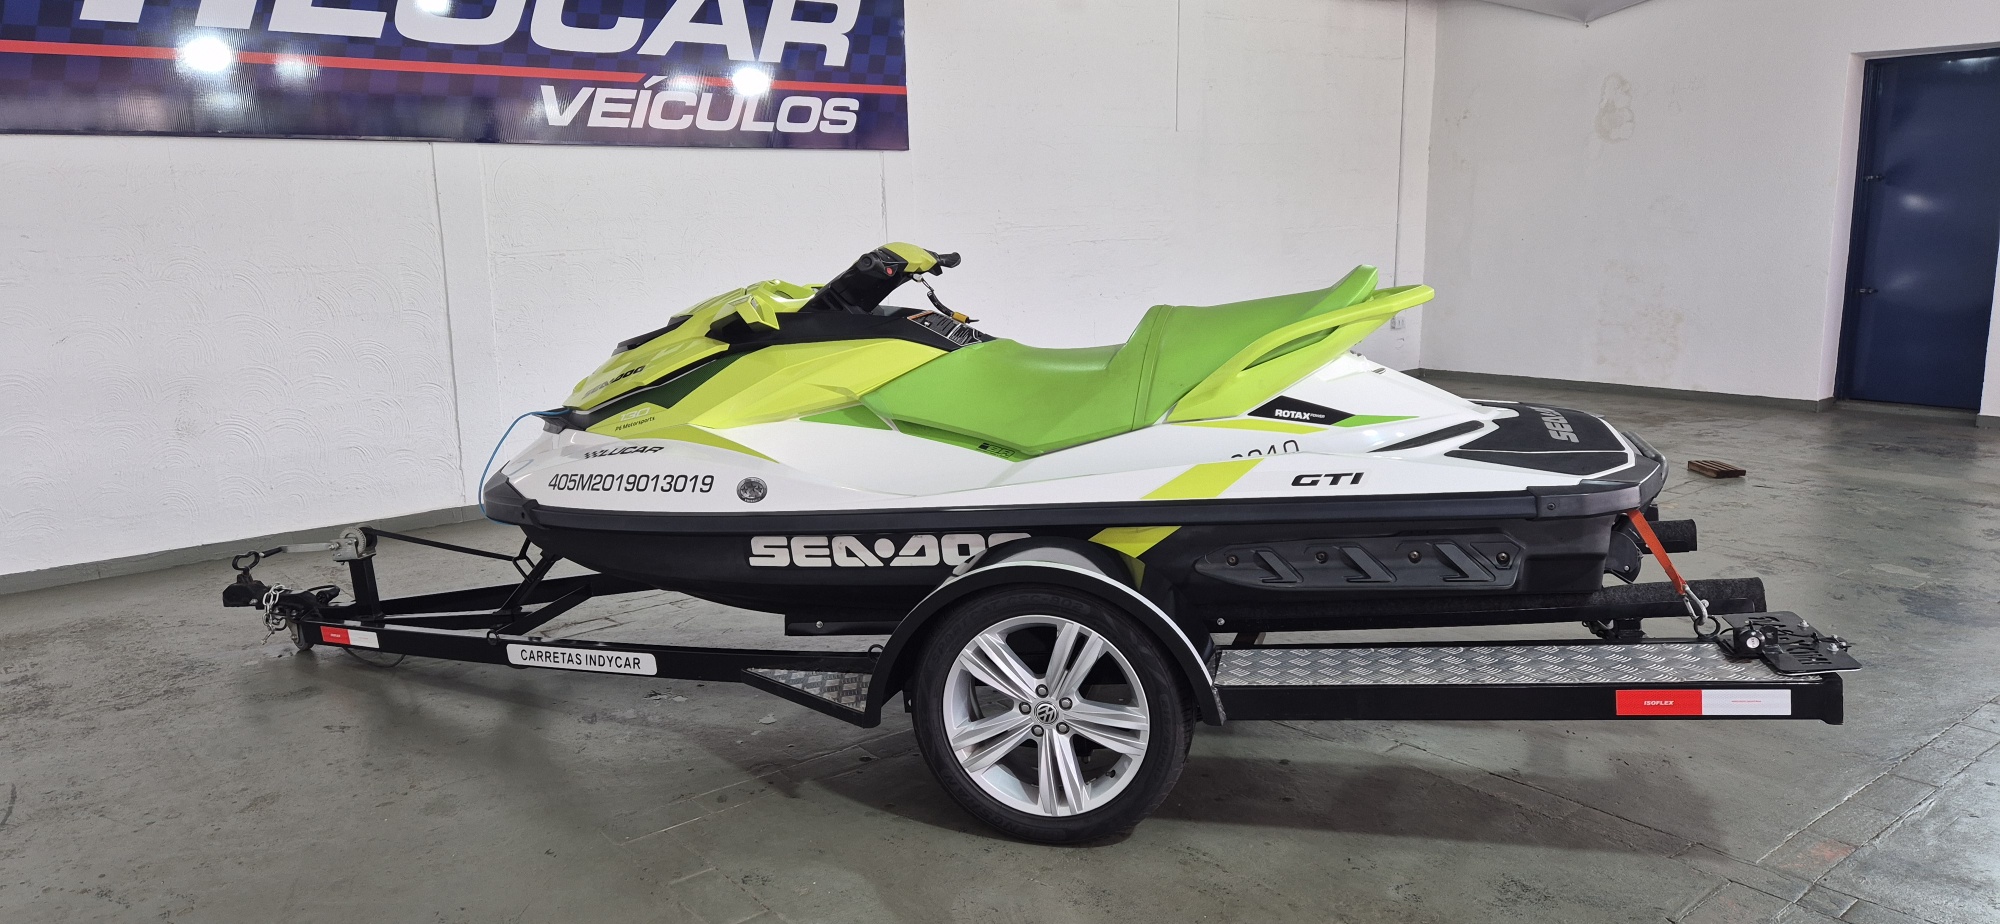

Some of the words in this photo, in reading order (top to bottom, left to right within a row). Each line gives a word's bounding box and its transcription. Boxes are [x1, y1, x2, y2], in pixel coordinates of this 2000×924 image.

[540, 76, 860, 133] VEÍCULOS
[621, 407, 650, 421] 130
[1275, 409, 1310, 420] ROTAX
[623, 416, 655, 429] Motorsports
[548, 473, 714, 493] 405M2019013019
[1291, 472, 1364, 486] GTI
[520, 649, 582, 666] CARRETAS
[585, 653, 641, 670] INDYCAR
